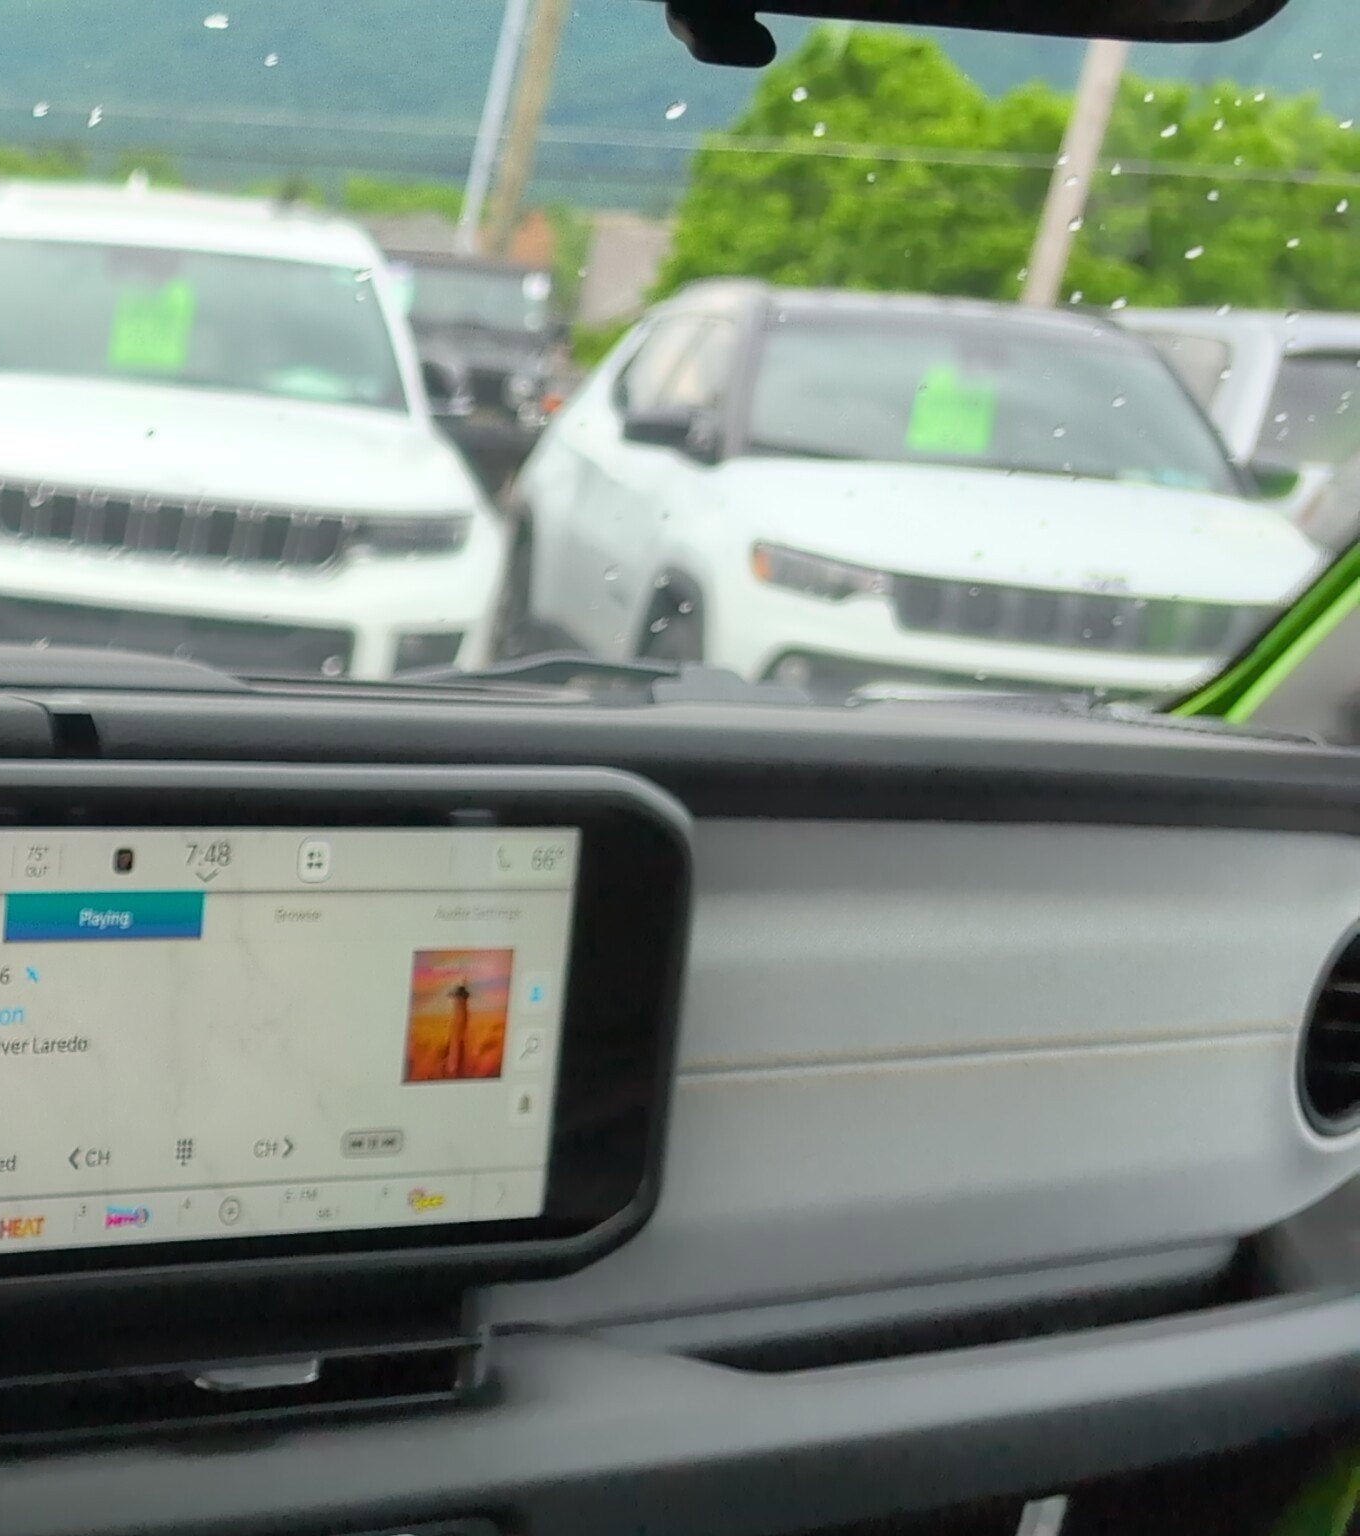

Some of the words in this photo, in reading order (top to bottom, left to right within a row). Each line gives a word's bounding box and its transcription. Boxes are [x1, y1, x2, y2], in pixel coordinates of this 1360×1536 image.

[183, 840, 233, 867] 7:48
[78, 907, 133, 931] Playing
[31, 1036, 89, 1054] Laredo
[84, 1149, 112, 1169] CH
[253, 1139, 279, 1159] CH
